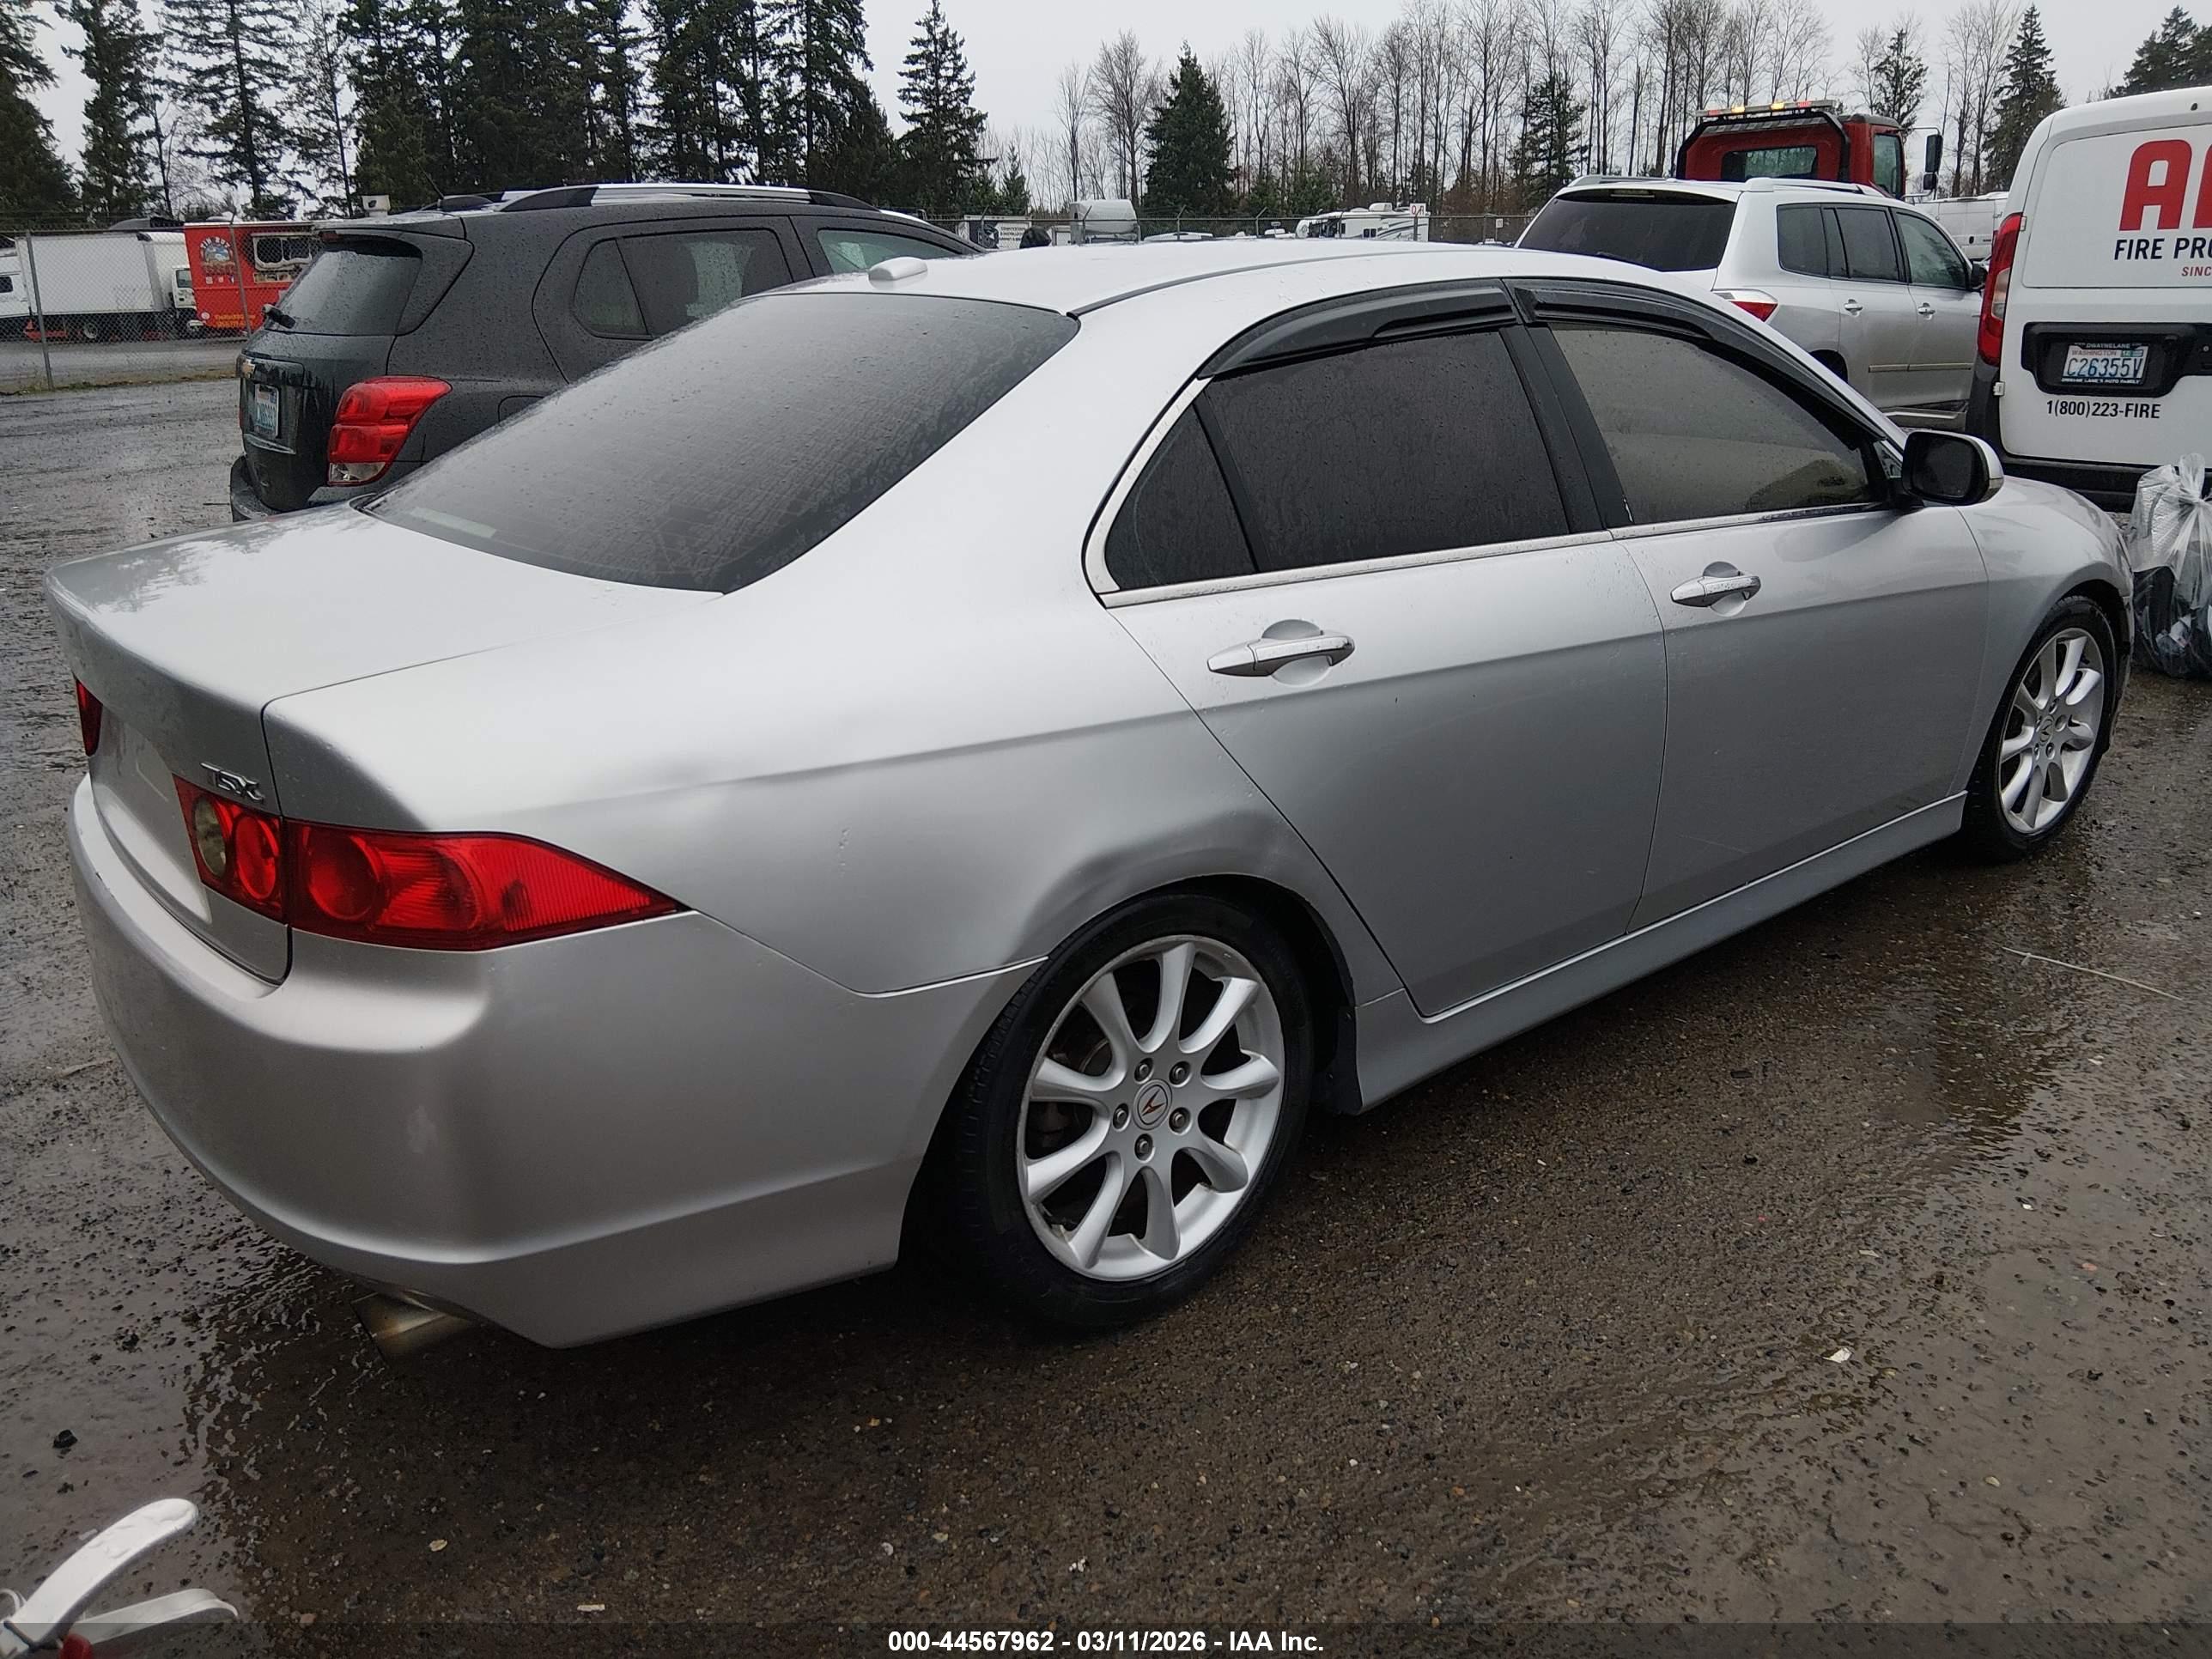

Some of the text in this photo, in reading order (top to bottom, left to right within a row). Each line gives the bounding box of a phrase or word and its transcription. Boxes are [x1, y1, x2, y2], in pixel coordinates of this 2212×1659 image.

[2119, 139, 2212, 231] A
[2114, 238, 2165, 260] FIRE
[2067, 357, 2143, 378] C26355V
[2047, 399, 2161, 418] 1(800)223-FIRE
[200, 761, 265, 802] TSX
